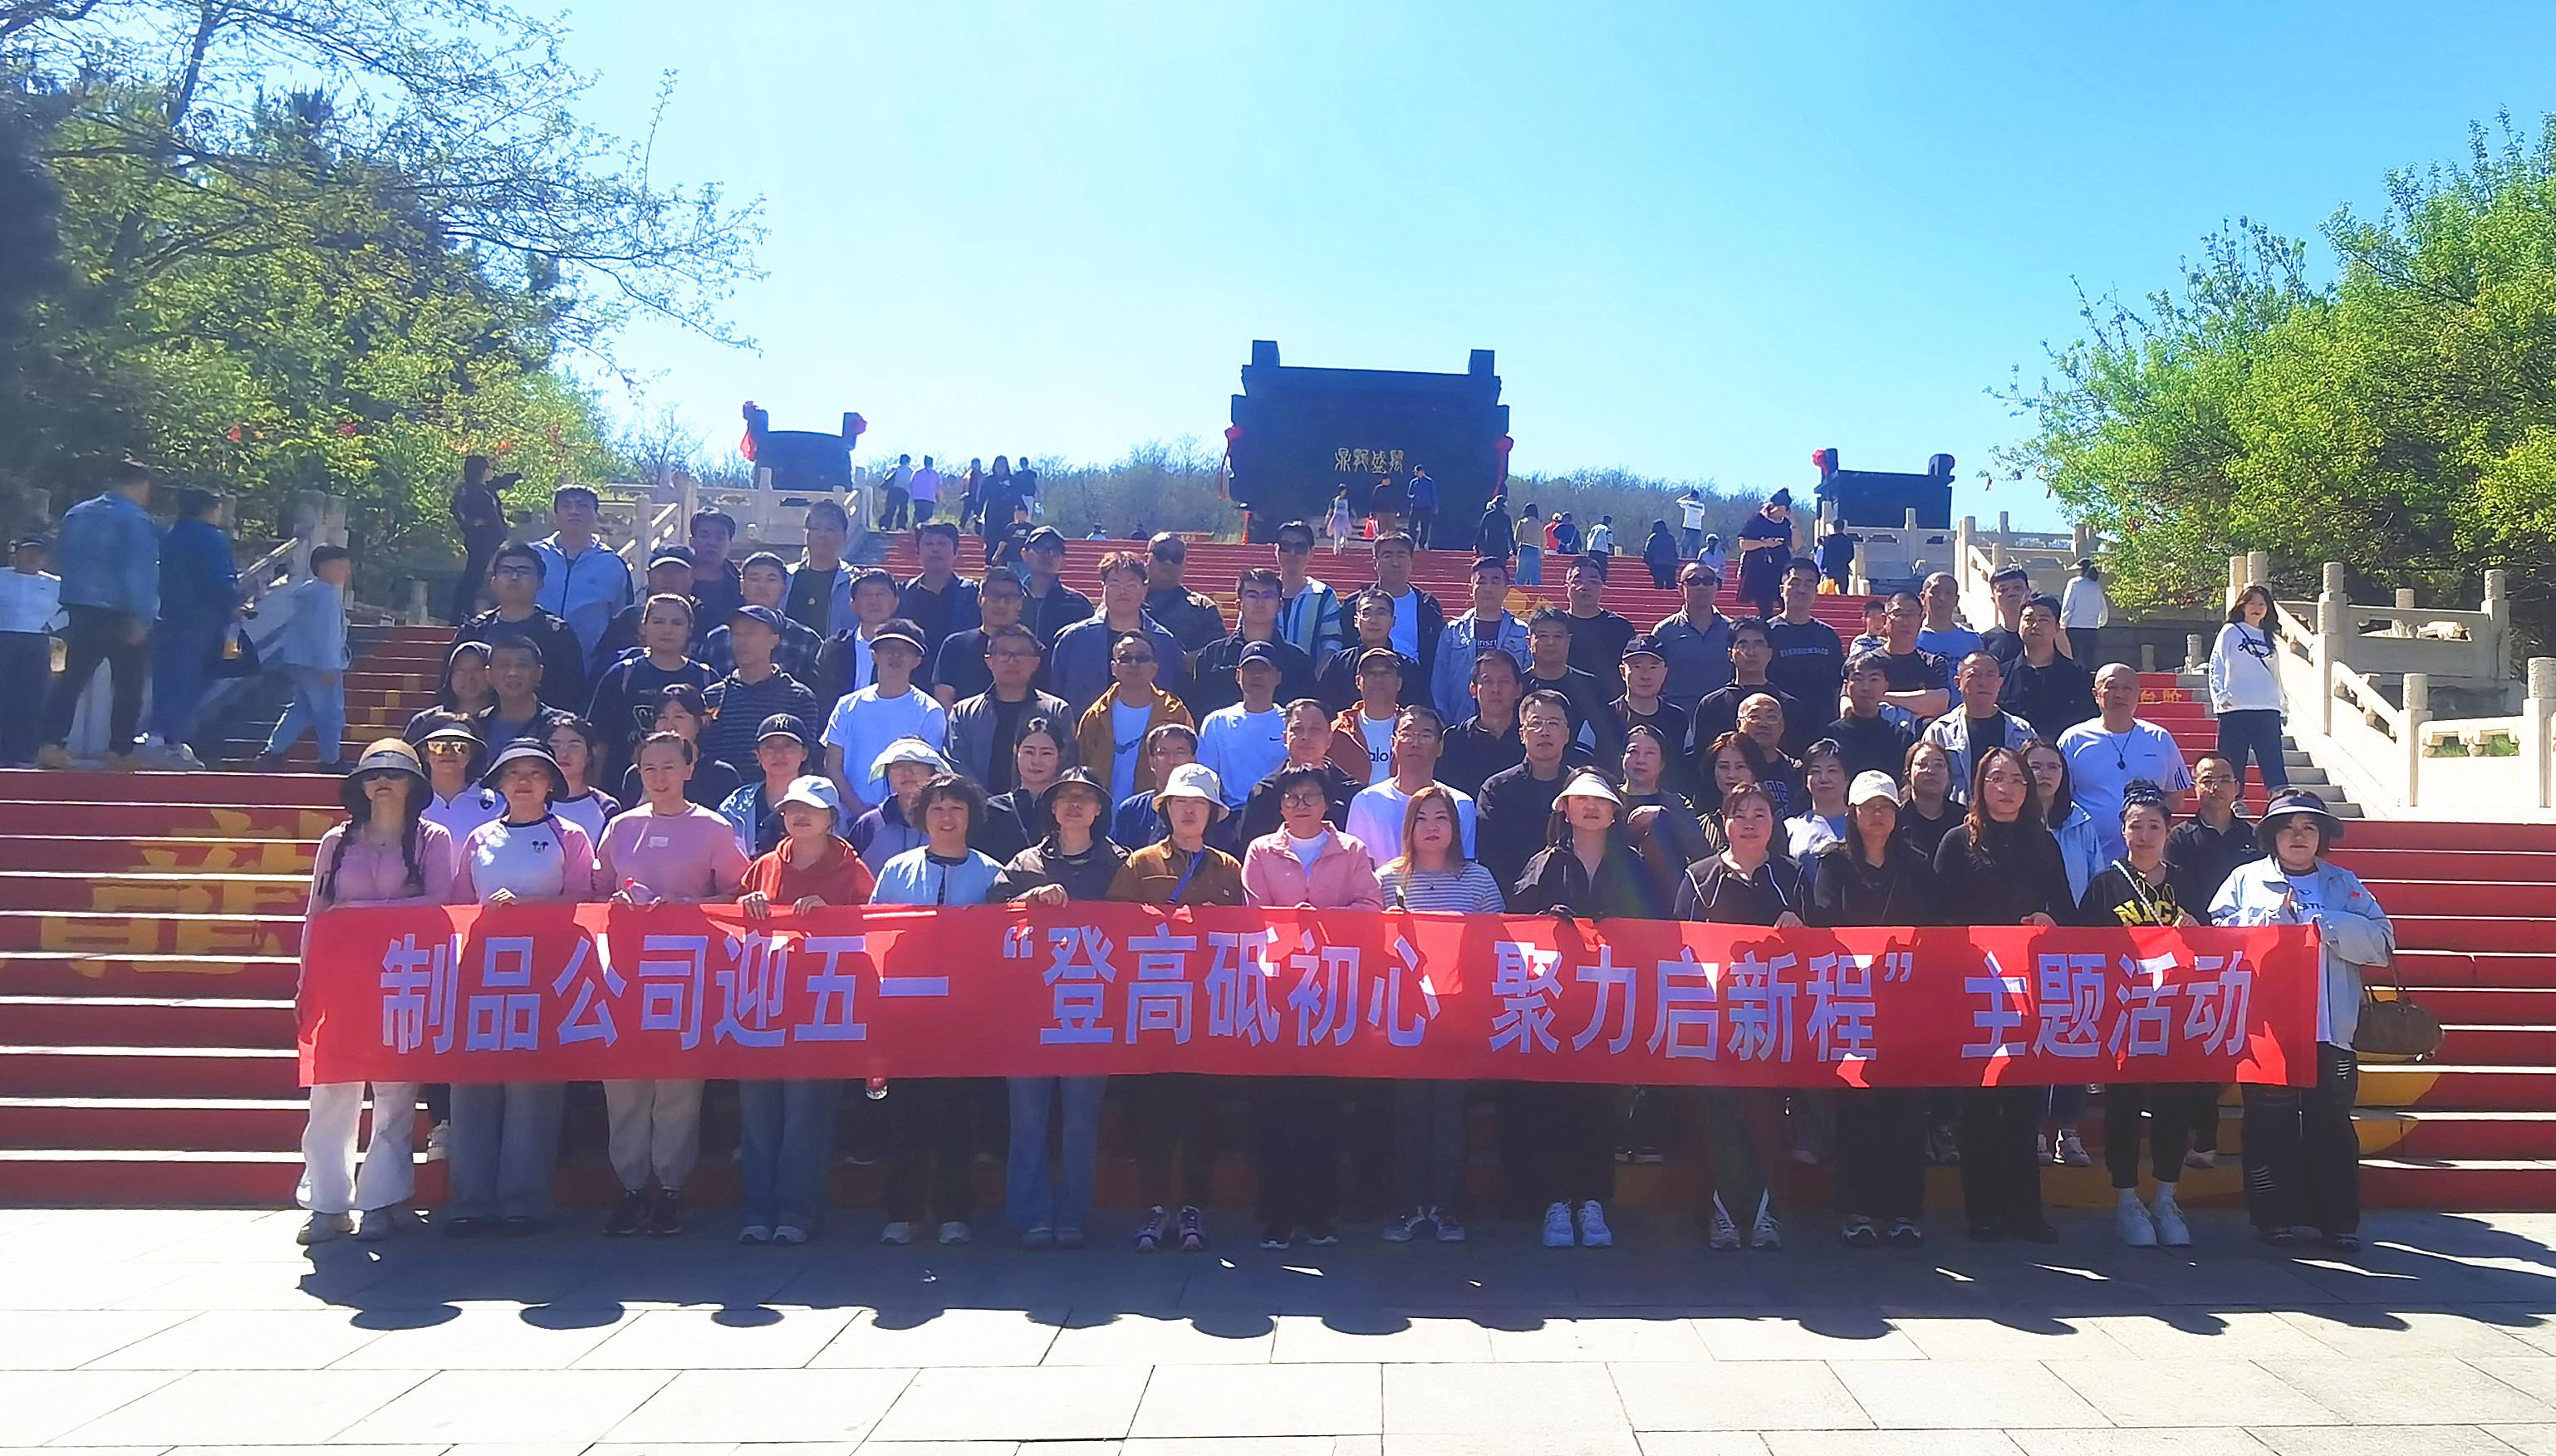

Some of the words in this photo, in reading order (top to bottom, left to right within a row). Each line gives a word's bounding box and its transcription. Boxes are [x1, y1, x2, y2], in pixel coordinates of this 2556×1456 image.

[1369, 746, 1392, 762] alo
[1960, 949, 2253, 1060] 主题活动
